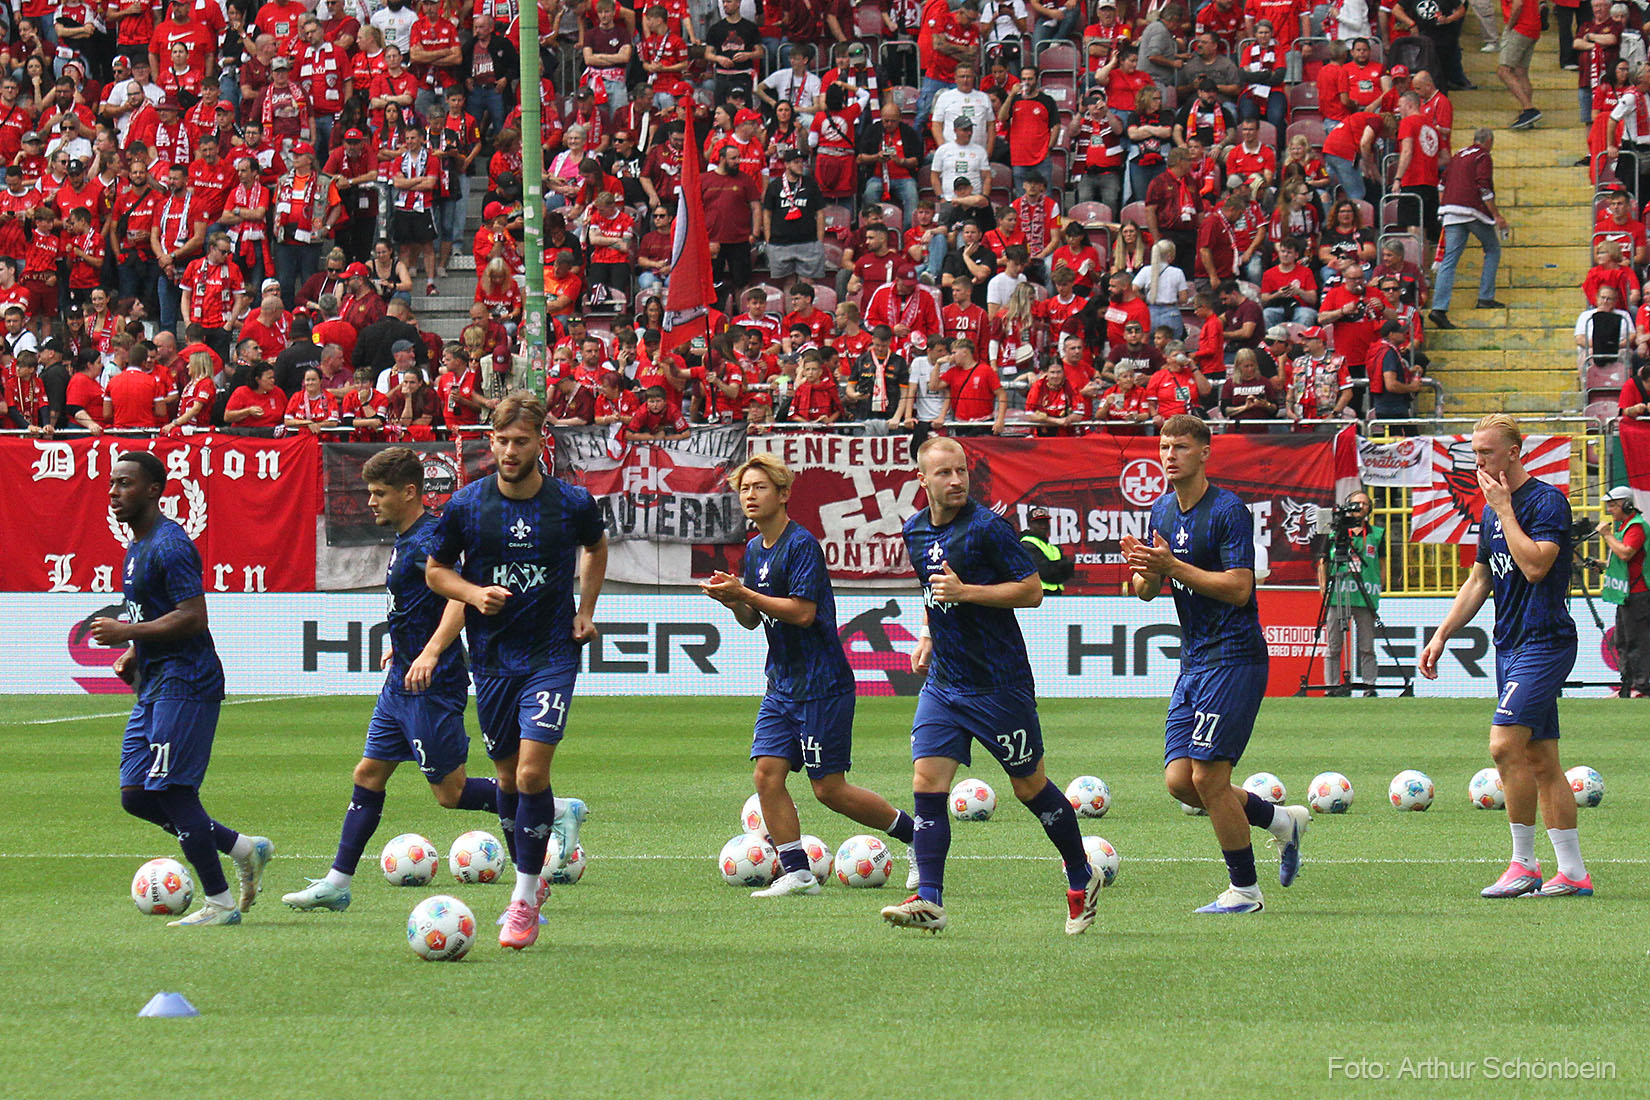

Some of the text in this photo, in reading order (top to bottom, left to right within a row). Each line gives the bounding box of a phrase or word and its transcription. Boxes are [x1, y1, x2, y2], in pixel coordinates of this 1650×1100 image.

[956, 316, 969, 330] 20
[44, 551, 268, 593] Larn
[1075, 553, 1102, 564] FCK
[530, 690, 566, 726] 34
[1191, 710, 1220, 743] 27
[150, 742, 171, 774] 21
[997, 728, 1033, 762] 32
